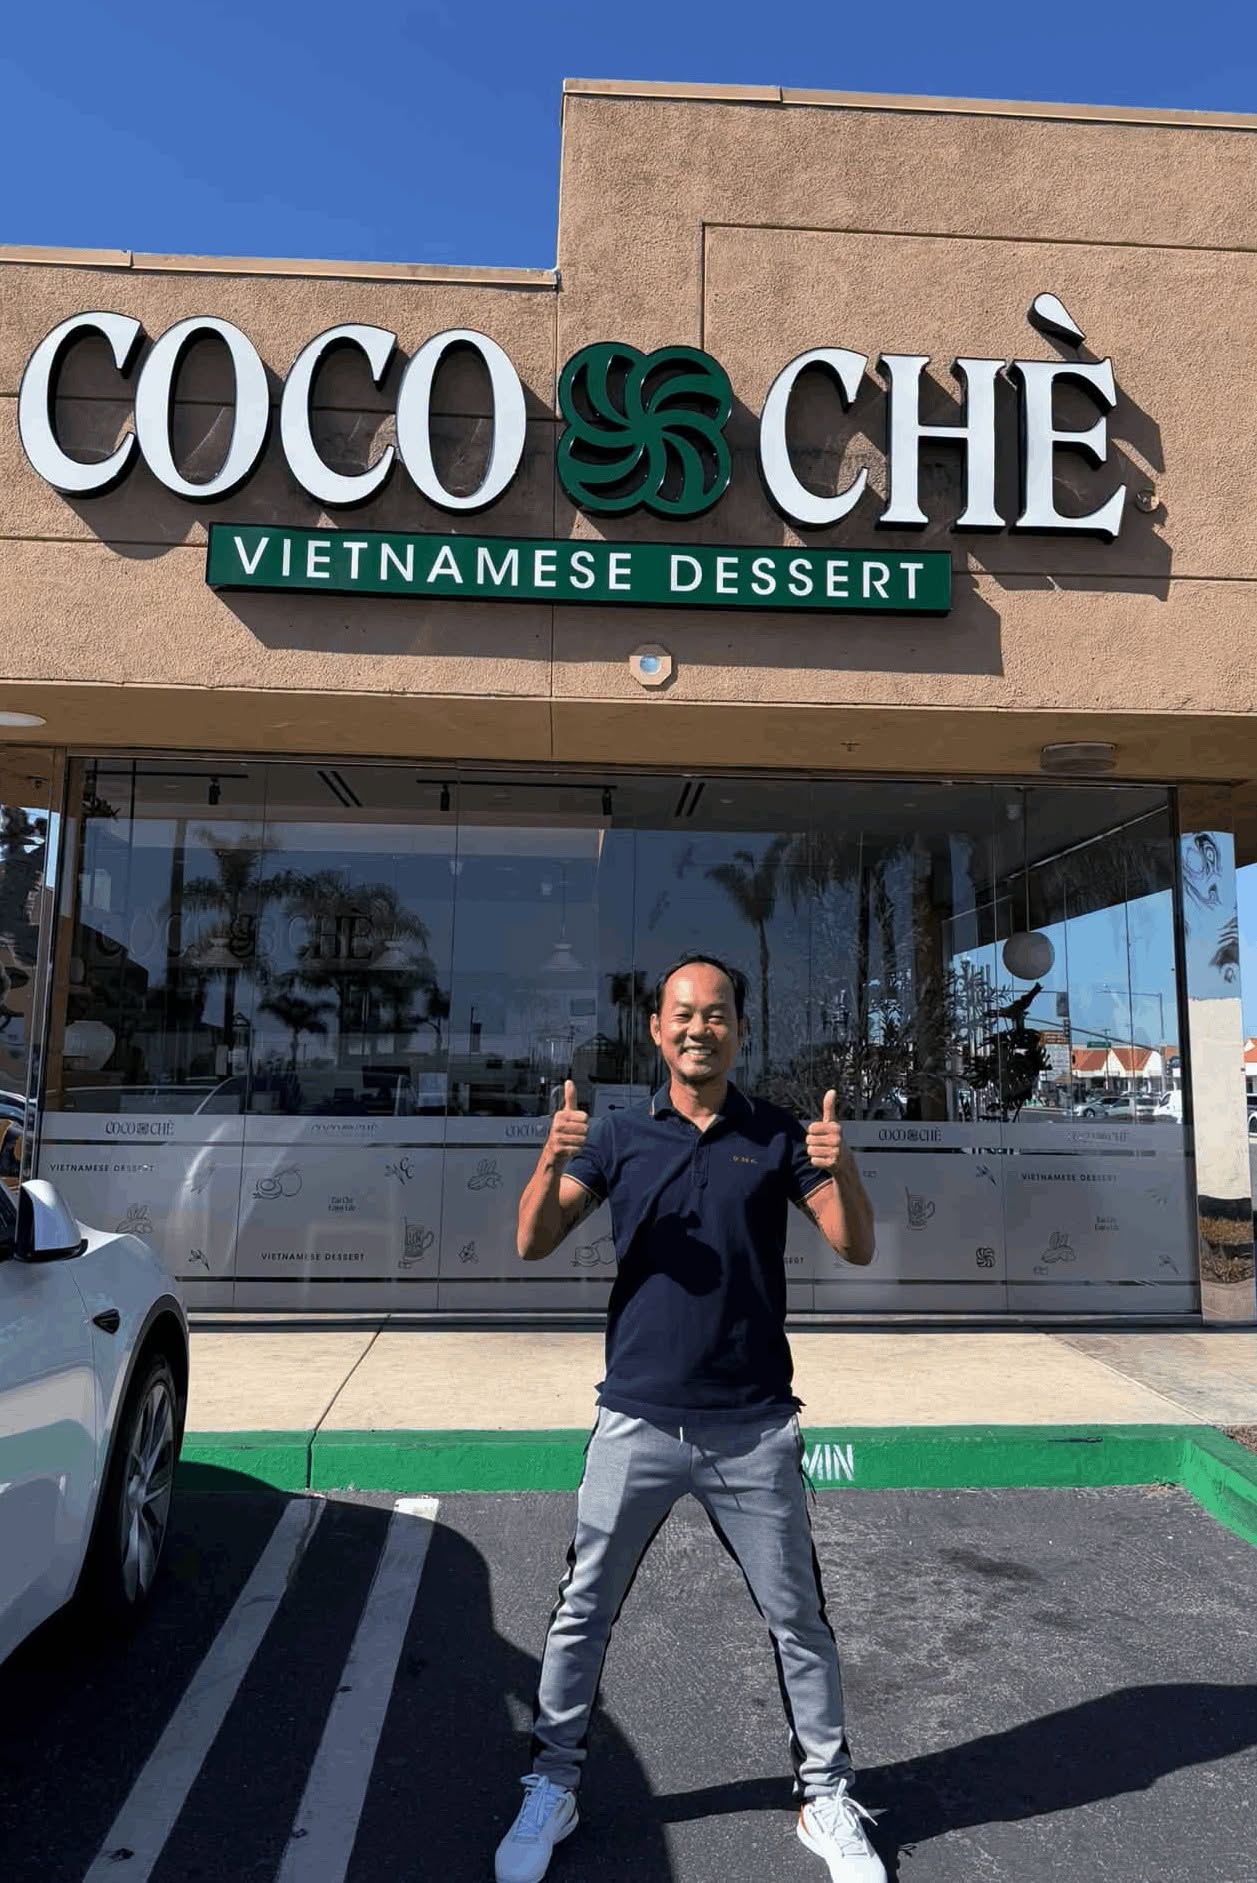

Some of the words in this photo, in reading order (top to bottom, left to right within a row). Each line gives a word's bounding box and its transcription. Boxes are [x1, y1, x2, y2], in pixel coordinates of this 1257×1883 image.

[18, 310, 527, 511] COCO
[759, 291, 1127, 539] CHÈ
[233, 535, 632, 591] VIETNAMESE
[670, 554, 925, 600] DESSERT
[49, 1164, 109, 1172] VIETNAMESE
[324, 1253, 365, 1261] DESSERT
[801, 1443, 854, 1481] MIN
